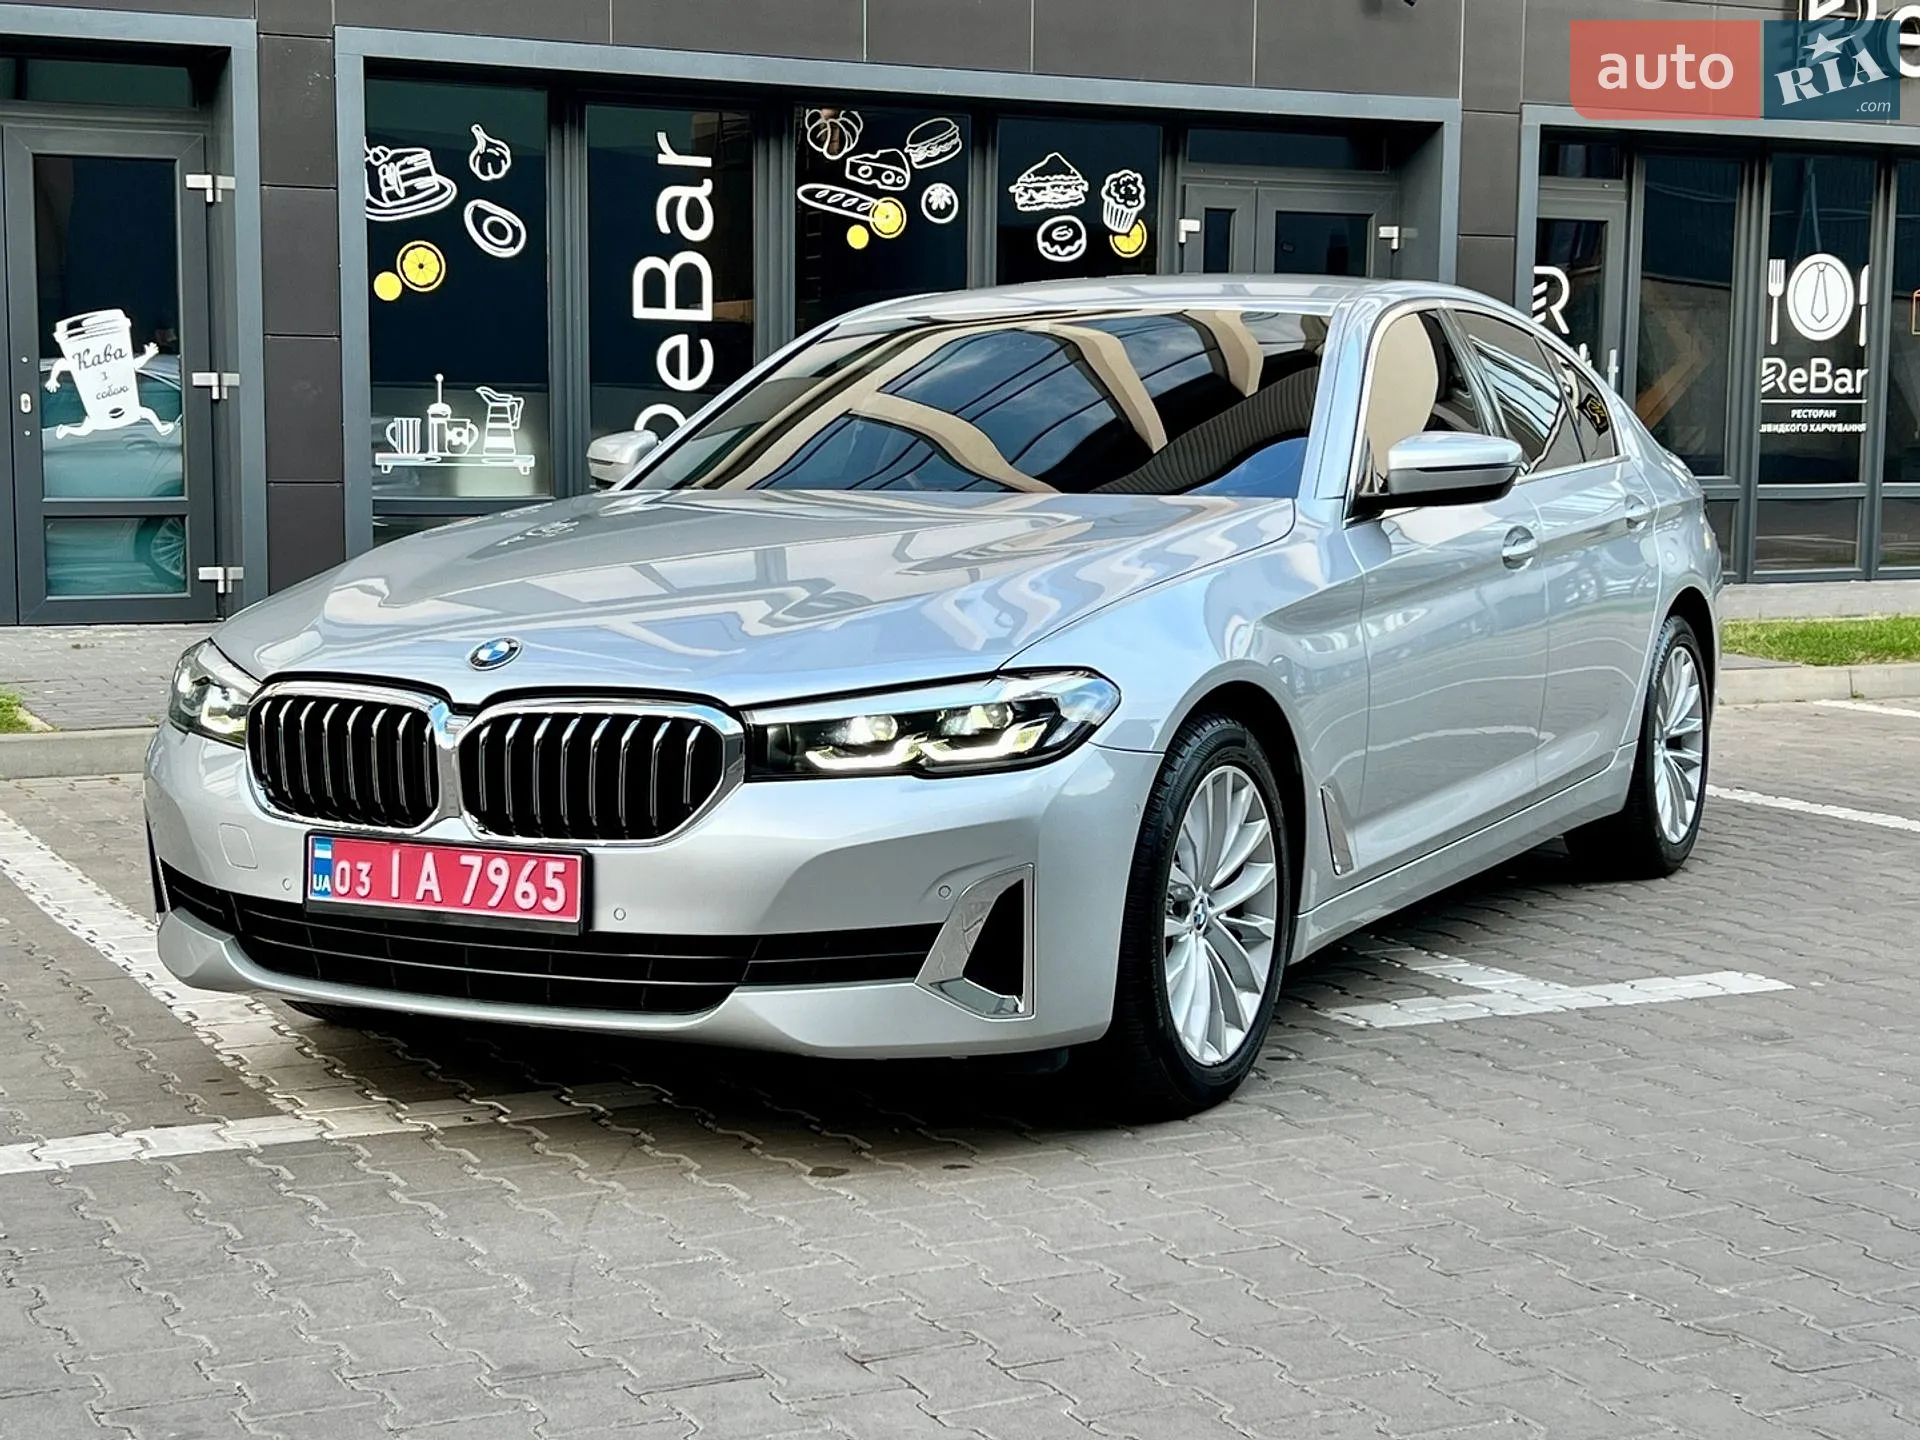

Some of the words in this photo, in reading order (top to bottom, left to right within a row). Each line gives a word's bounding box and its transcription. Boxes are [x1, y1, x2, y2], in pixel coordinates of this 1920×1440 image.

[72, 343, 128, 371] Кава
[1761, 357, 1869, 394] ReBar
[95, 384, 129, 400] собою
[1791, 409, 1837, 419] РЕСТОРАН
[312, 874, 331, 893] UA
[334, 859, 373, 898] 03
[459, 854, 568, 913] 7965
